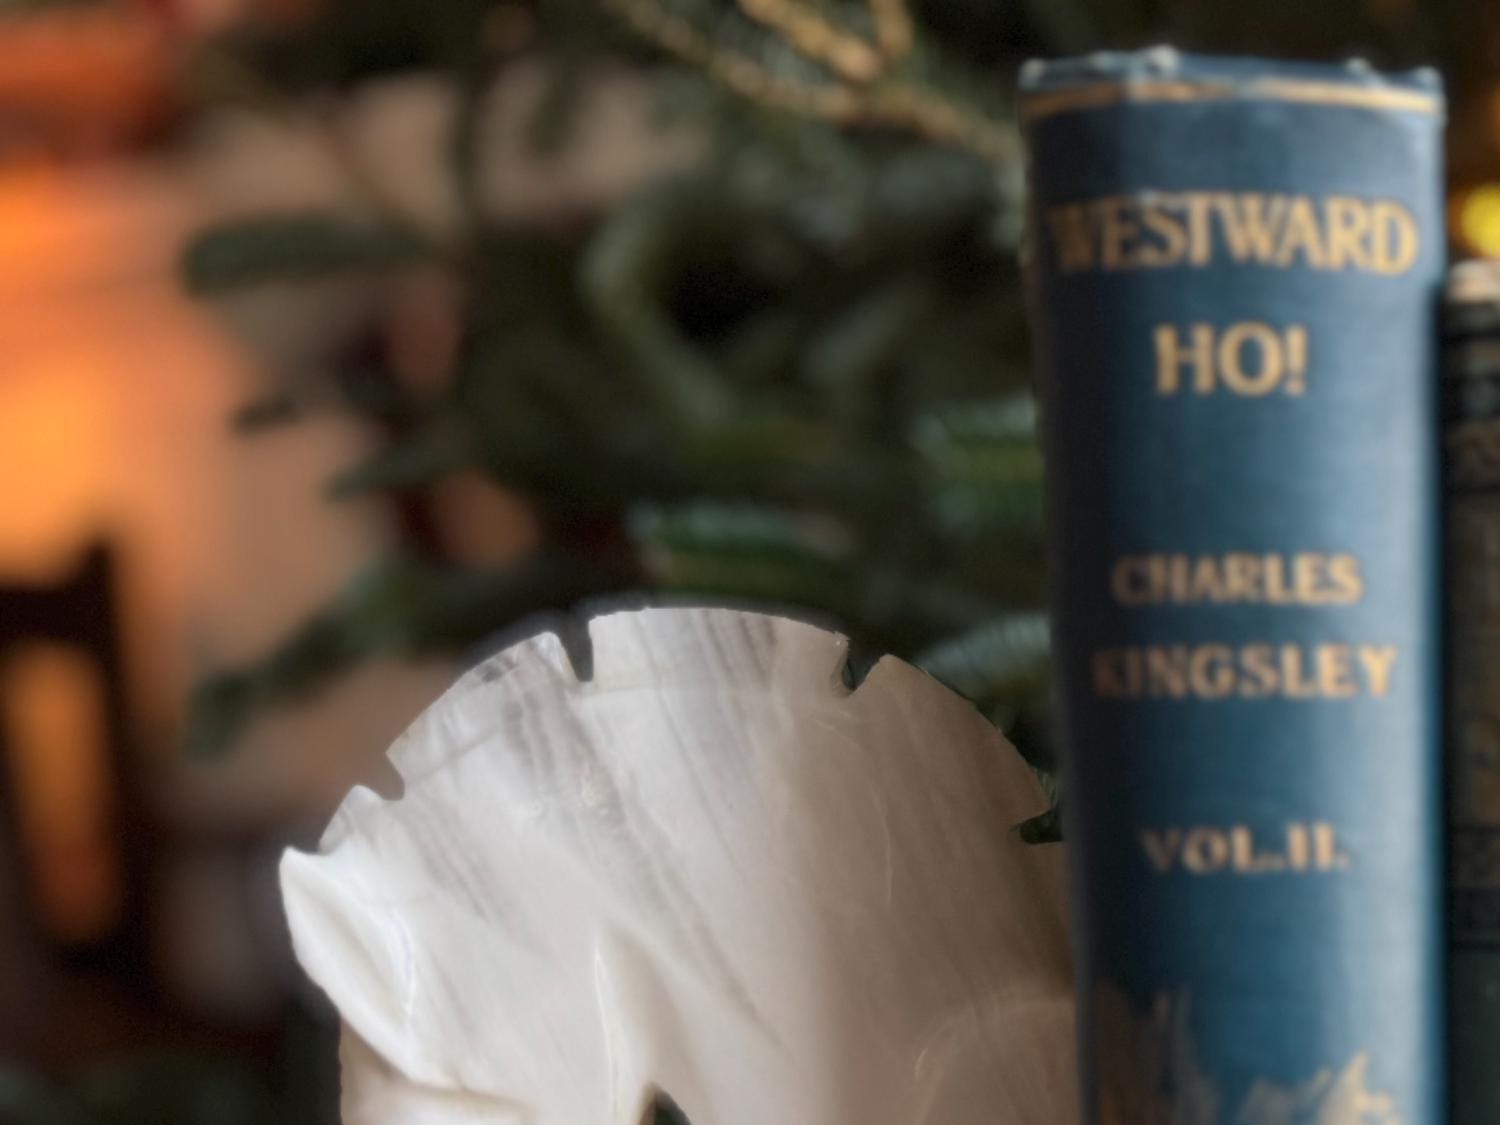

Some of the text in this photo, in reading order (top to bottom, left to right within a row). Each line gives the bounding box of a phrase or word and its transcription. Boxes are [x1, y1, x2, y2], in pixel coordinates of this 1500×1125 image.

[1050, 190, 1418, 276] WESTWARD
[1154, 321, 1309, 397] HO!
[1112, 552, 1364, 604] CHARLES
[1092, 644, 1397, 699] KINGSLEY
